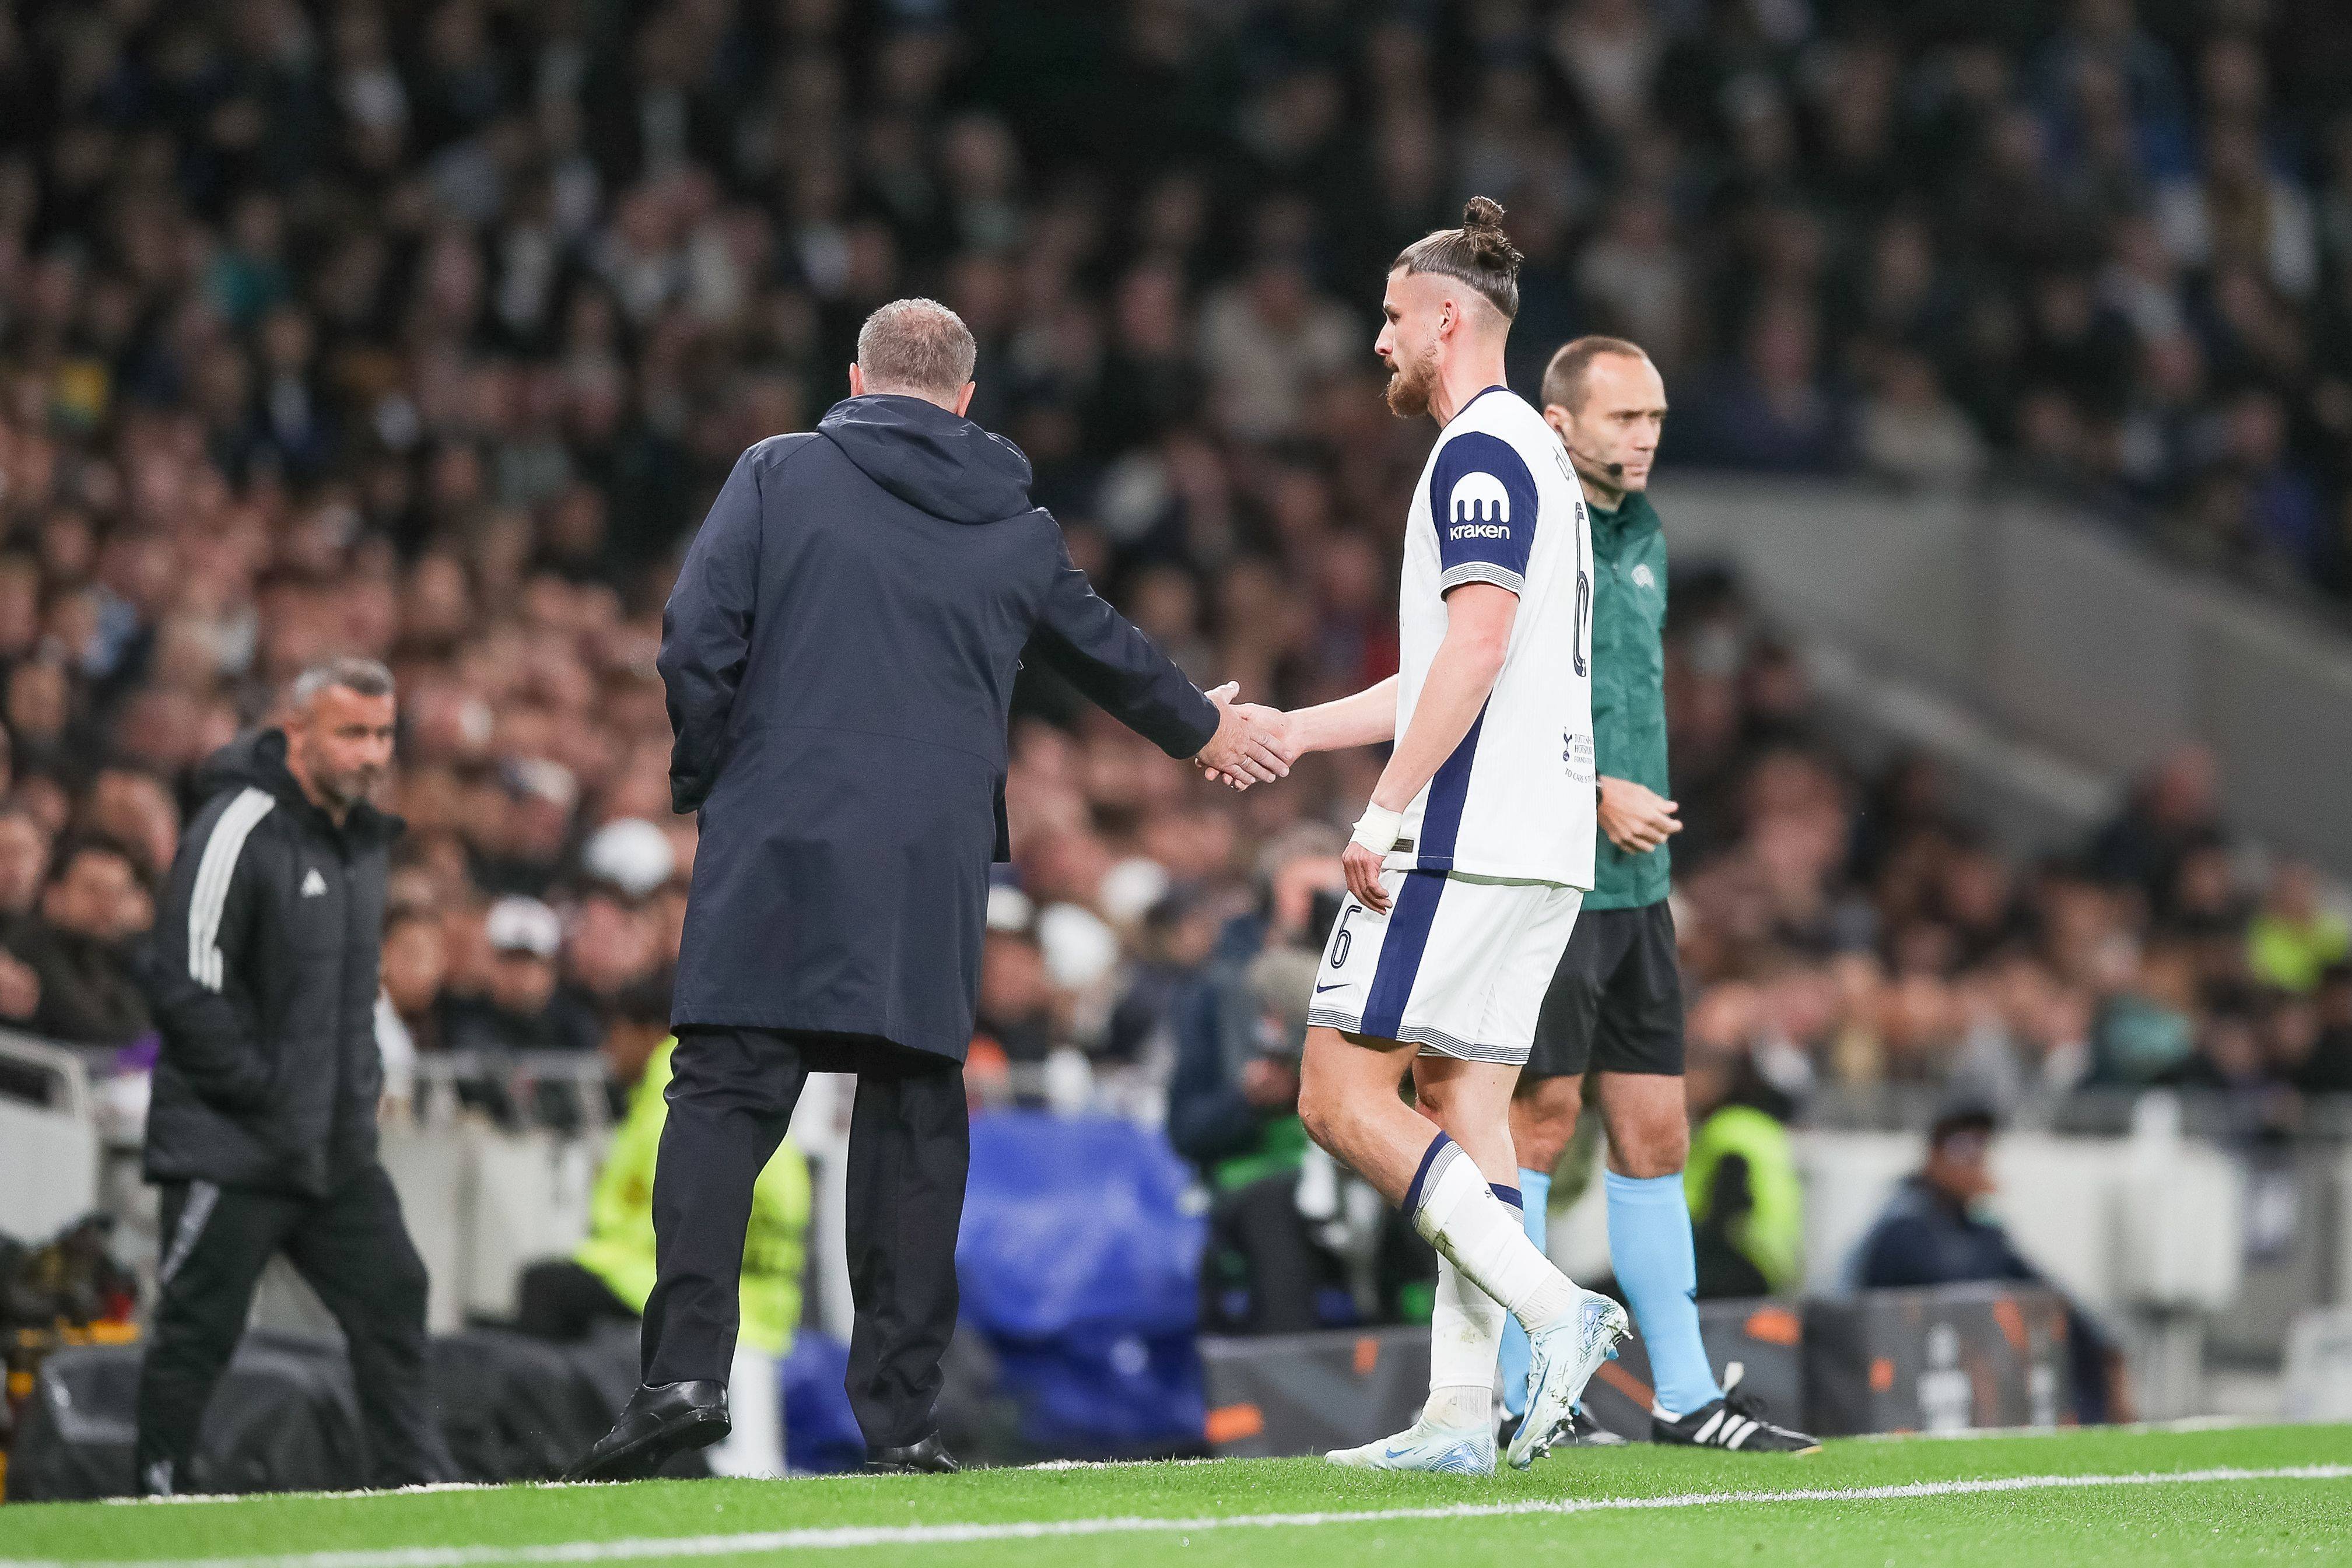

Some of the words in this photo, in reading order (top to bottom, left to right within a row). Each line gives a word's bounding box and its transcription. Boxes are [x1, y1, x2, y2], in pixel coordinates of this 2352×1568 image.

[1450, 524, 1510, 541] kraken
[1565, 767, 1572, 777] TO
[1331, 904, 1362, 969] 6
